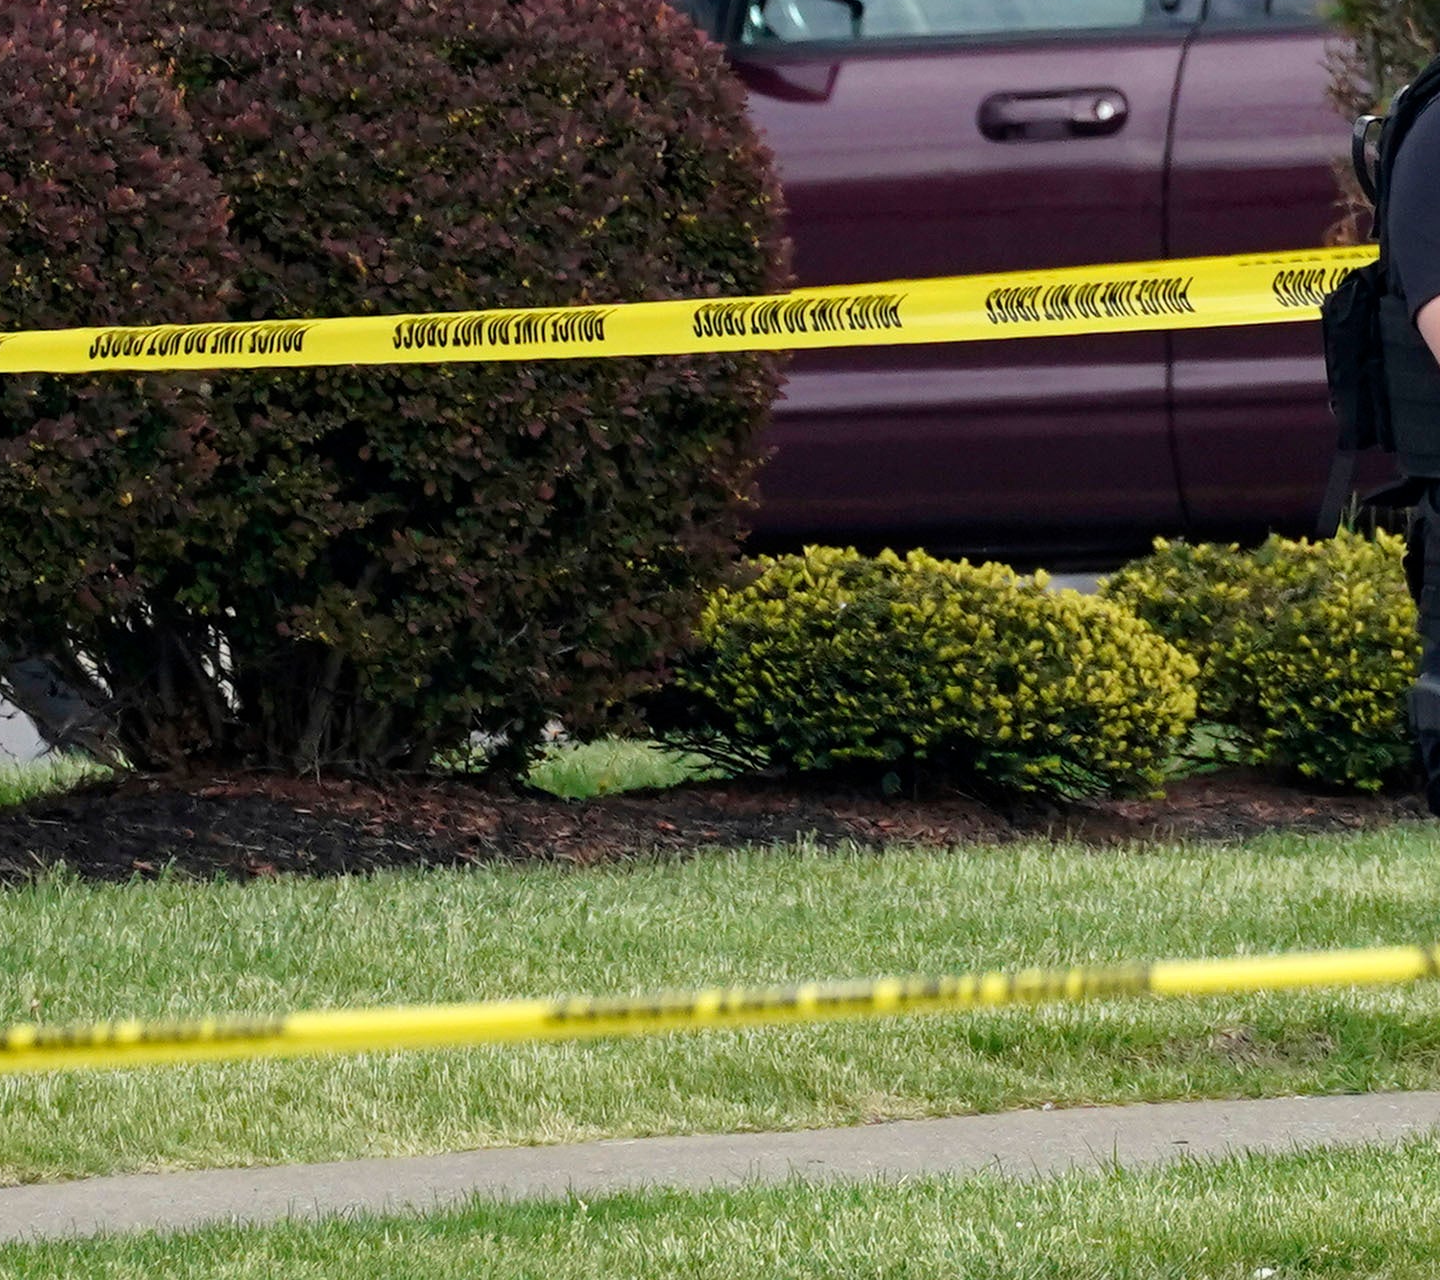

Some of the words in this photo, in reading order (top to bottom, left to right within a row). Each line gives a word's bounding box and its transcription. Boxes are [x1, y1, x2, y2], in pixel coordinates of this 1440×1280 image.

[847, 294, 908, 329] POLICE
[985, 286, 1044, 324] CROSS
[1043, 284, 1077, 320] NOT
[1075, 283, 1102, 319] DO
[1099, 280, 1138, 317] LINE
[1136, 276, 1196, 314] POLICE
[693, 302, 753, 338] CROSS
[751, 300, 783, 335] NOT
[783, 299, 811, 333] DO
[810, 297, 848, 332] LINE
